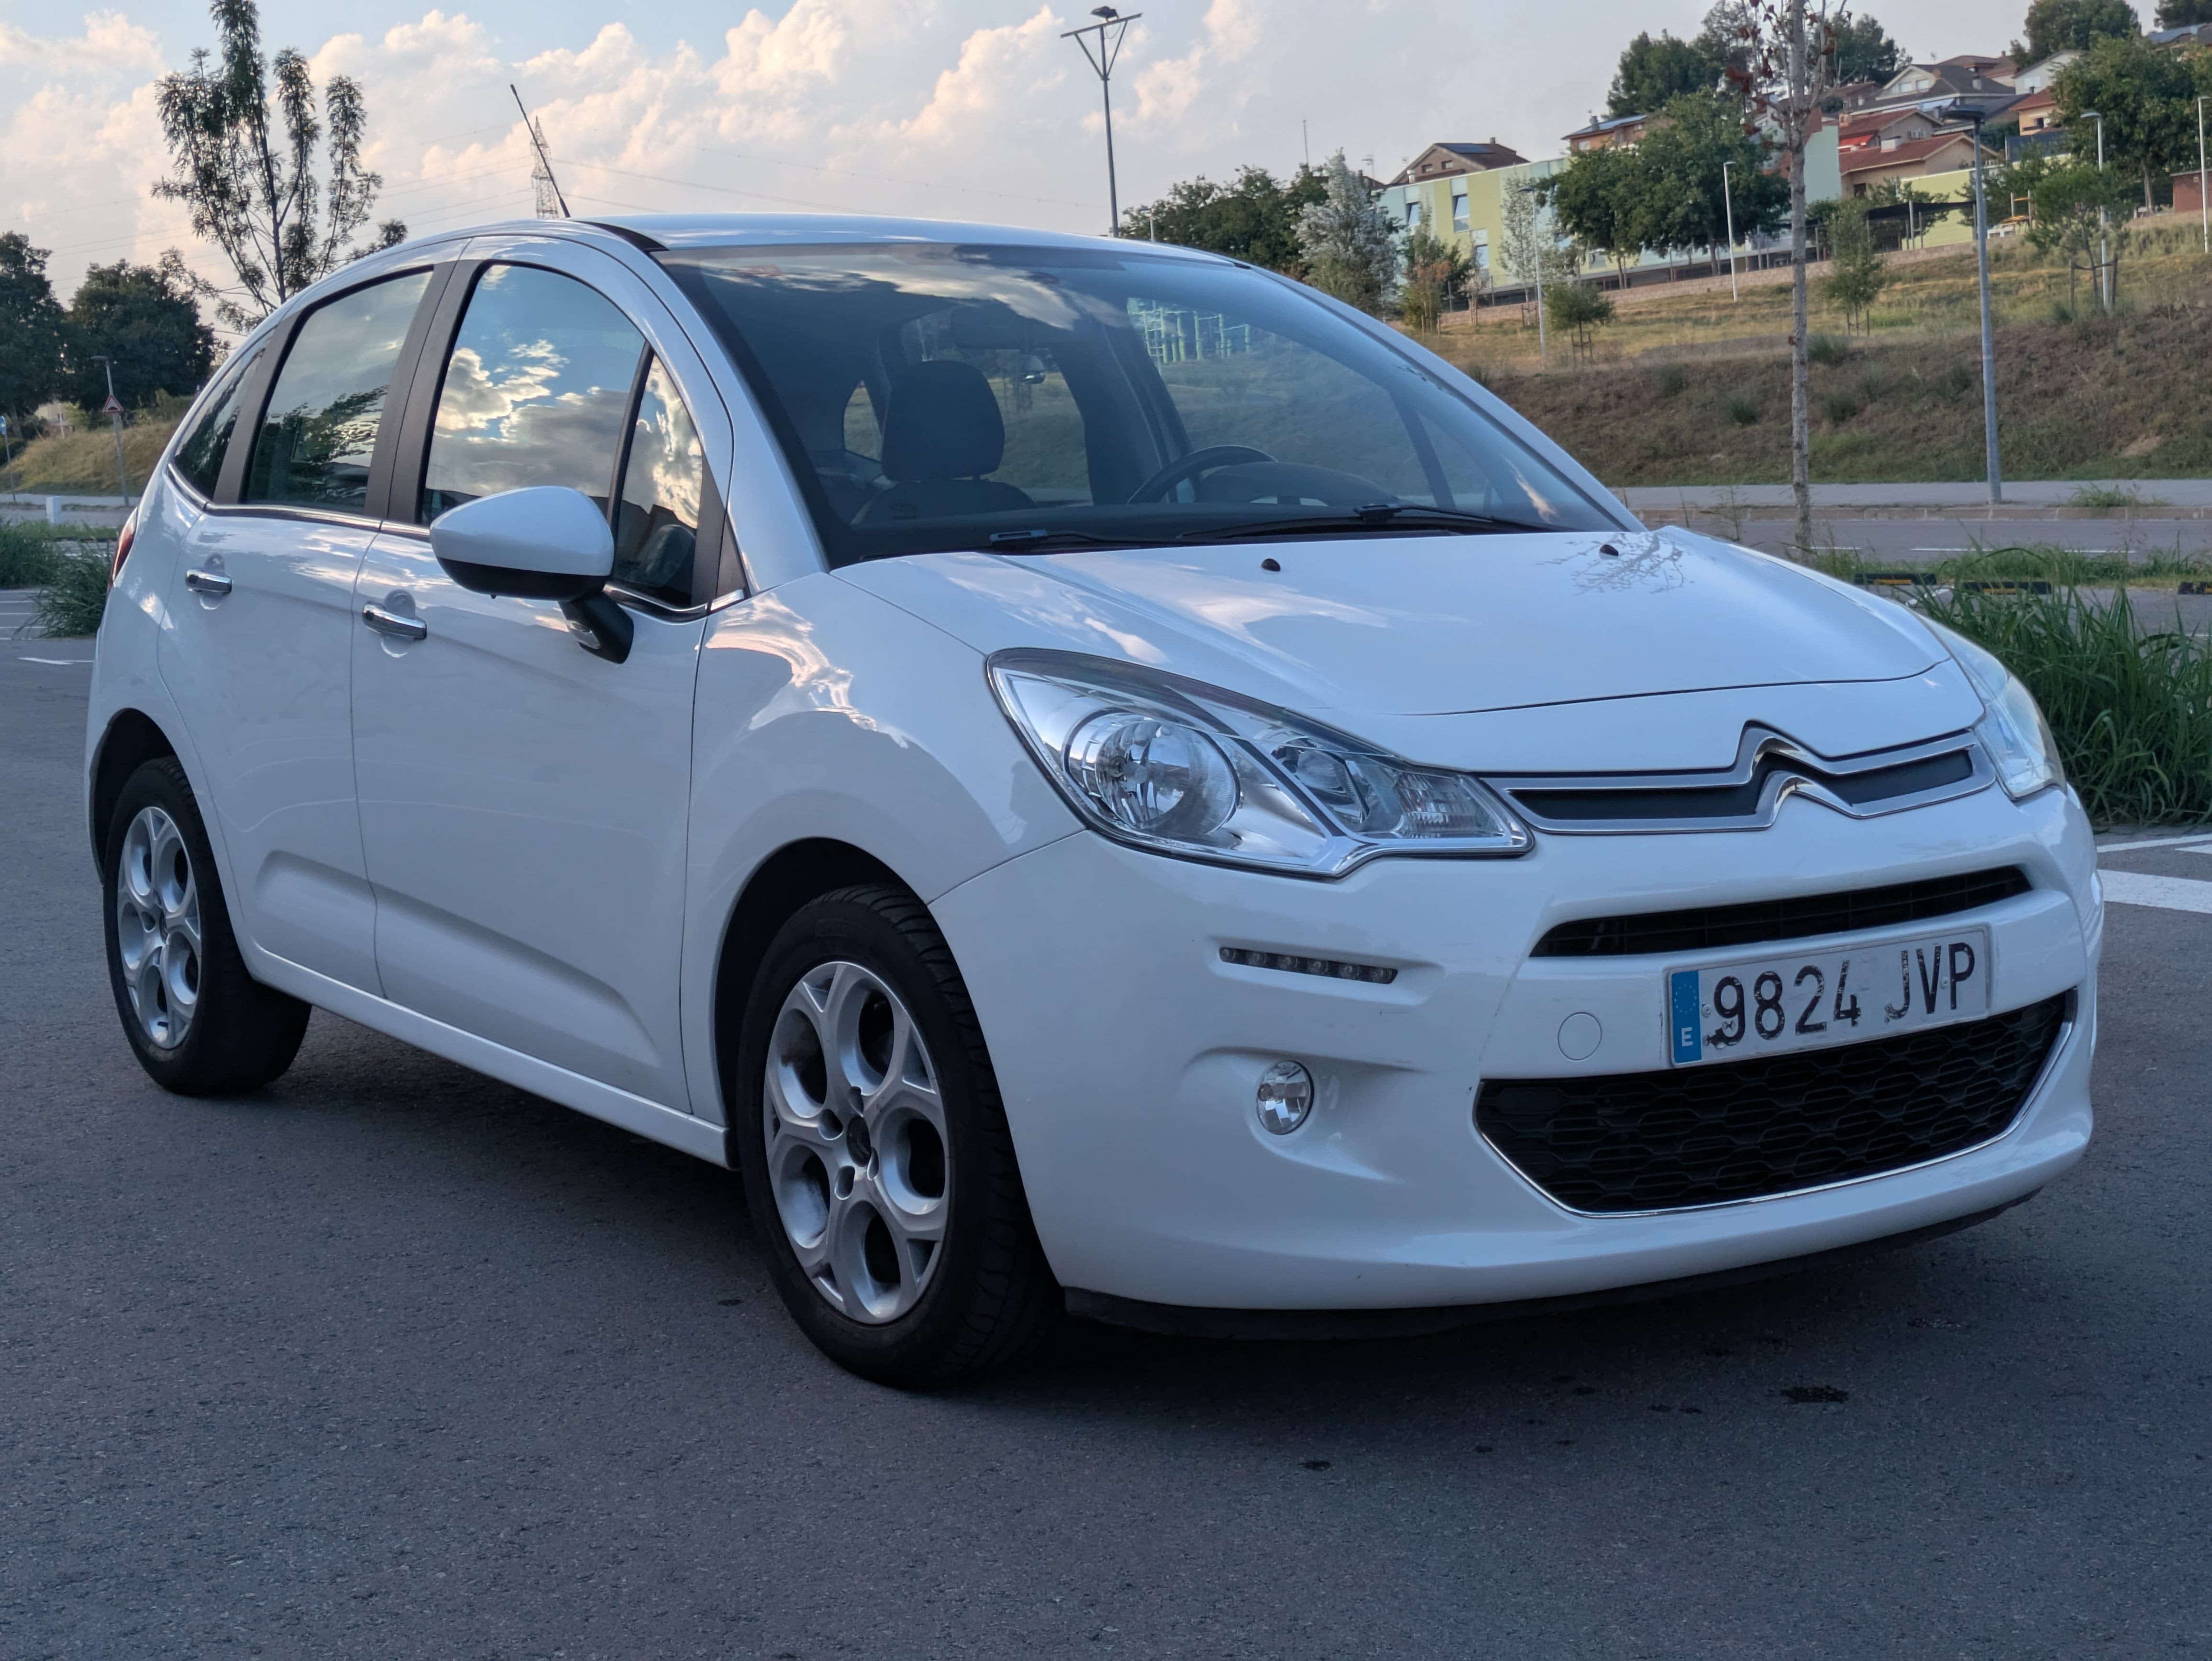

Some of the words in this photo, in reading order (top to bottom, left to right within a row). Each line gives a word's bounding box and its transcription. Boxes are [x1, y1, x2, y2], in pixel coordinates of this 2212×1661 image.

[1713, 959, 1861, 1047] 9824
[1884, 942, 1975, 1020] JVP
[1681, 1027, 1693, 1047] E
